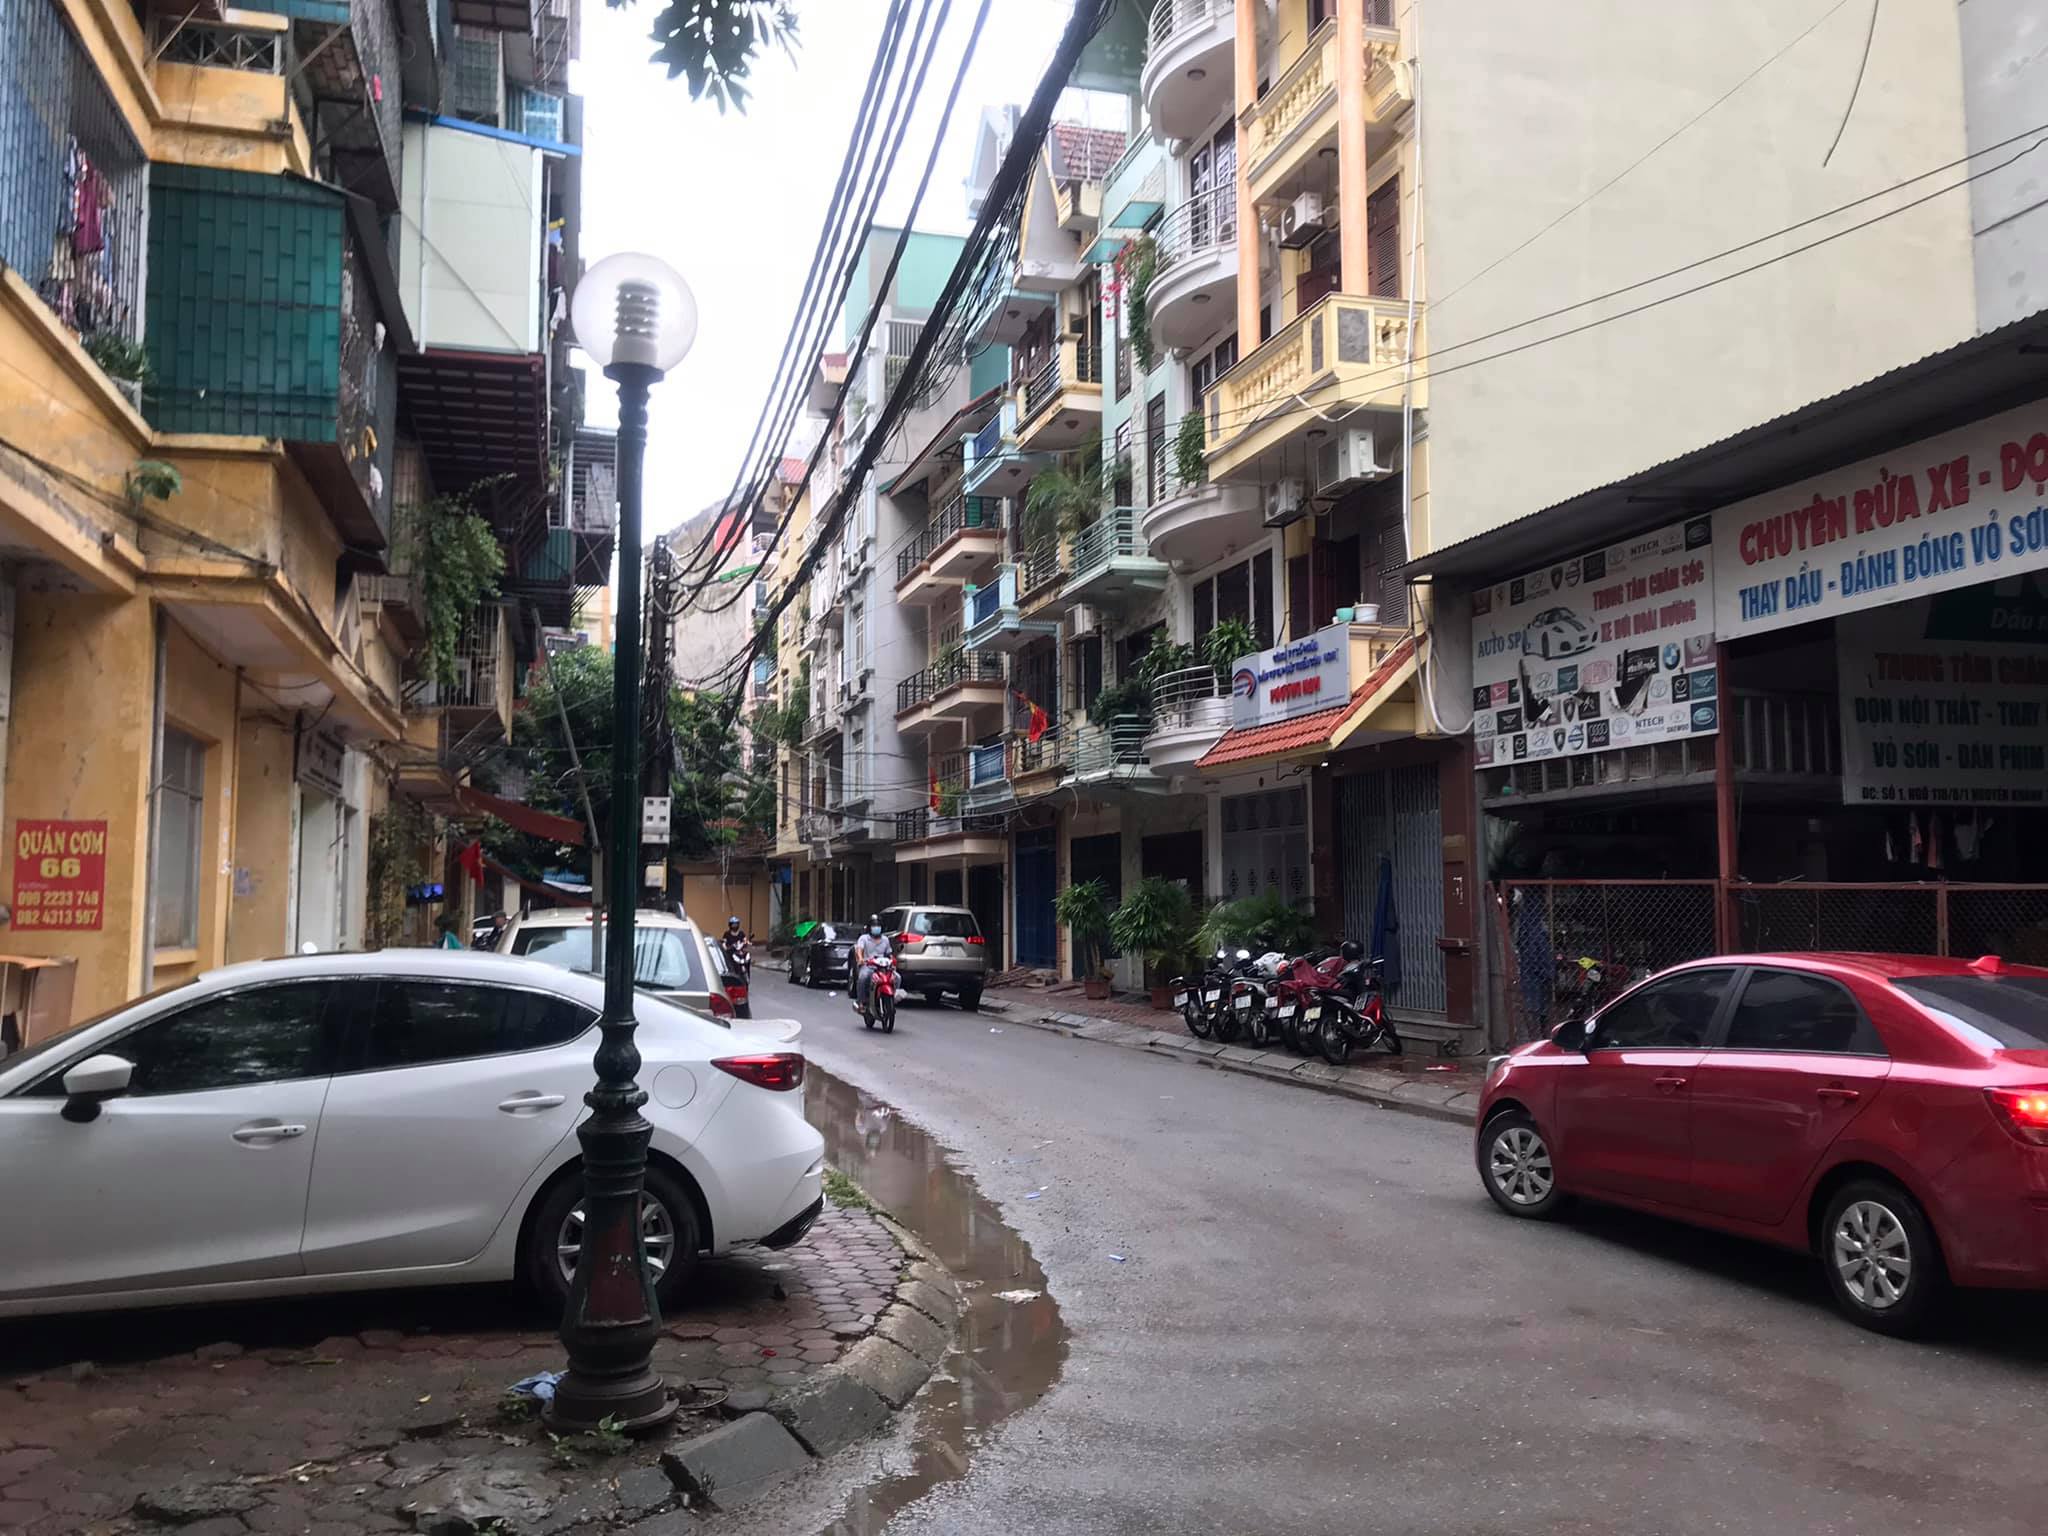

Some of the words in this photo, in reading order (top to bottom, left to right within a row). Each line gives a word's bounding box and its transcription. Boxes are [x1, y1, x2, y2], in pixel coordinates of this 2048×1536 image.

[1739, 493, 1847, 565] CHUYÊN
[1854, 467, 1920, 534] RỬA
[1927, 455, 1969, 514] XE
[1682, 558, 1704, 586] SÓC
[1739, 580, 1781, 622] THAY
[1786, 561, 1823, 611] DẦU
[1841, 549, 1897, 598] ĐÁNH
[1904, 532, 1965, 580] BÓNG
[1971, 509, 2001, 566] VỎ
[1635, 716, 1664, 728] NTECH
[19, 825, 66, 860] QUÁN
[69, 829, 104, 856] CƠM
[40, 858, 80, 878] 66
